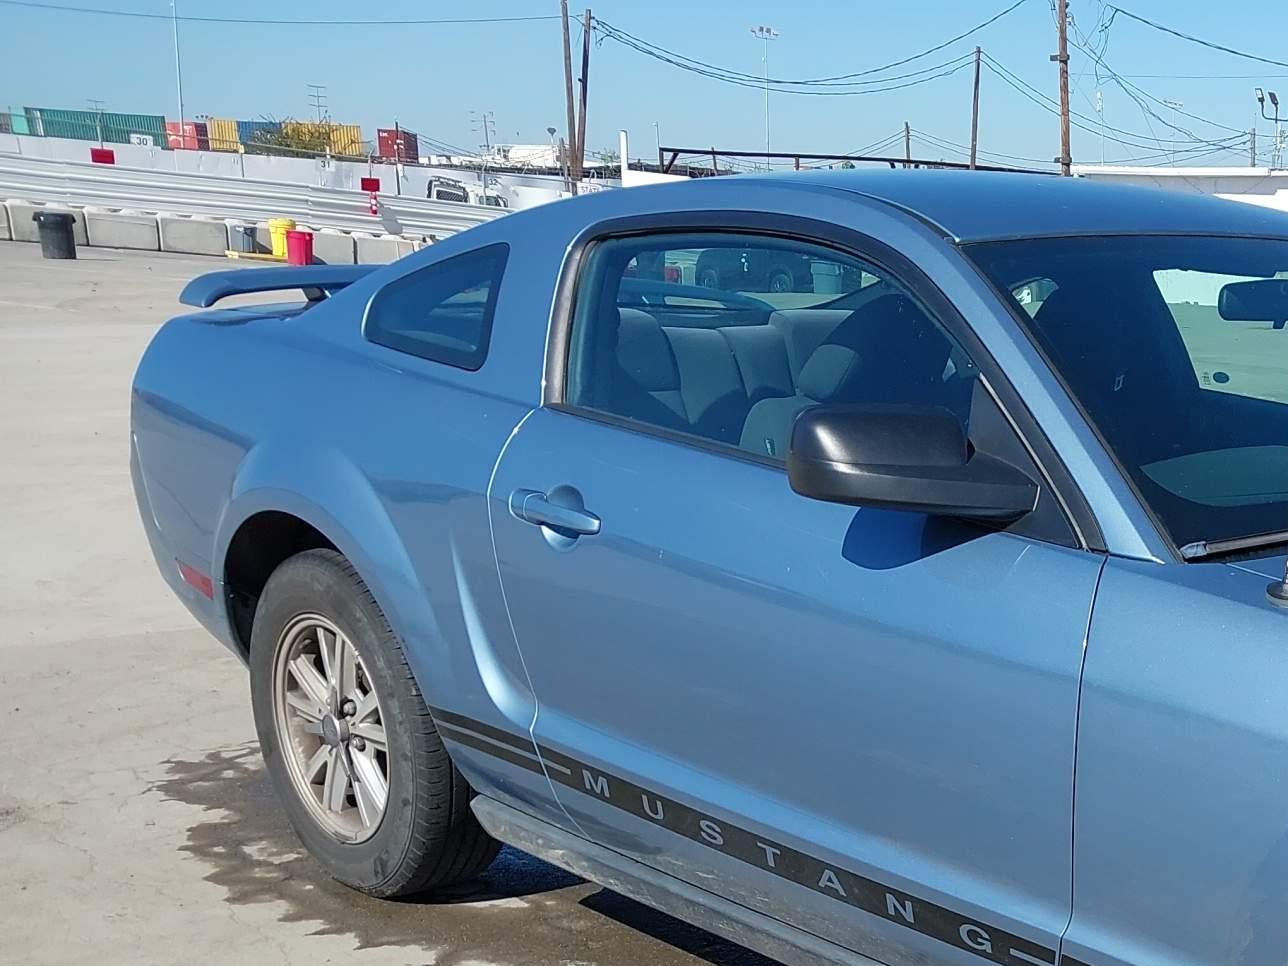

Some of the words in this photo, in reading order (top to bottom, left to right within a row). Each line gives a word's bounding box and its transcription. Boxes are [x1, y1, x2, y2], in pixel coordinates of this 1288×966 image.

[136, 136, 148, 146] 30
[320, 160, 330, 168] 31
[582, 768, 993, 955] MUSTANG
